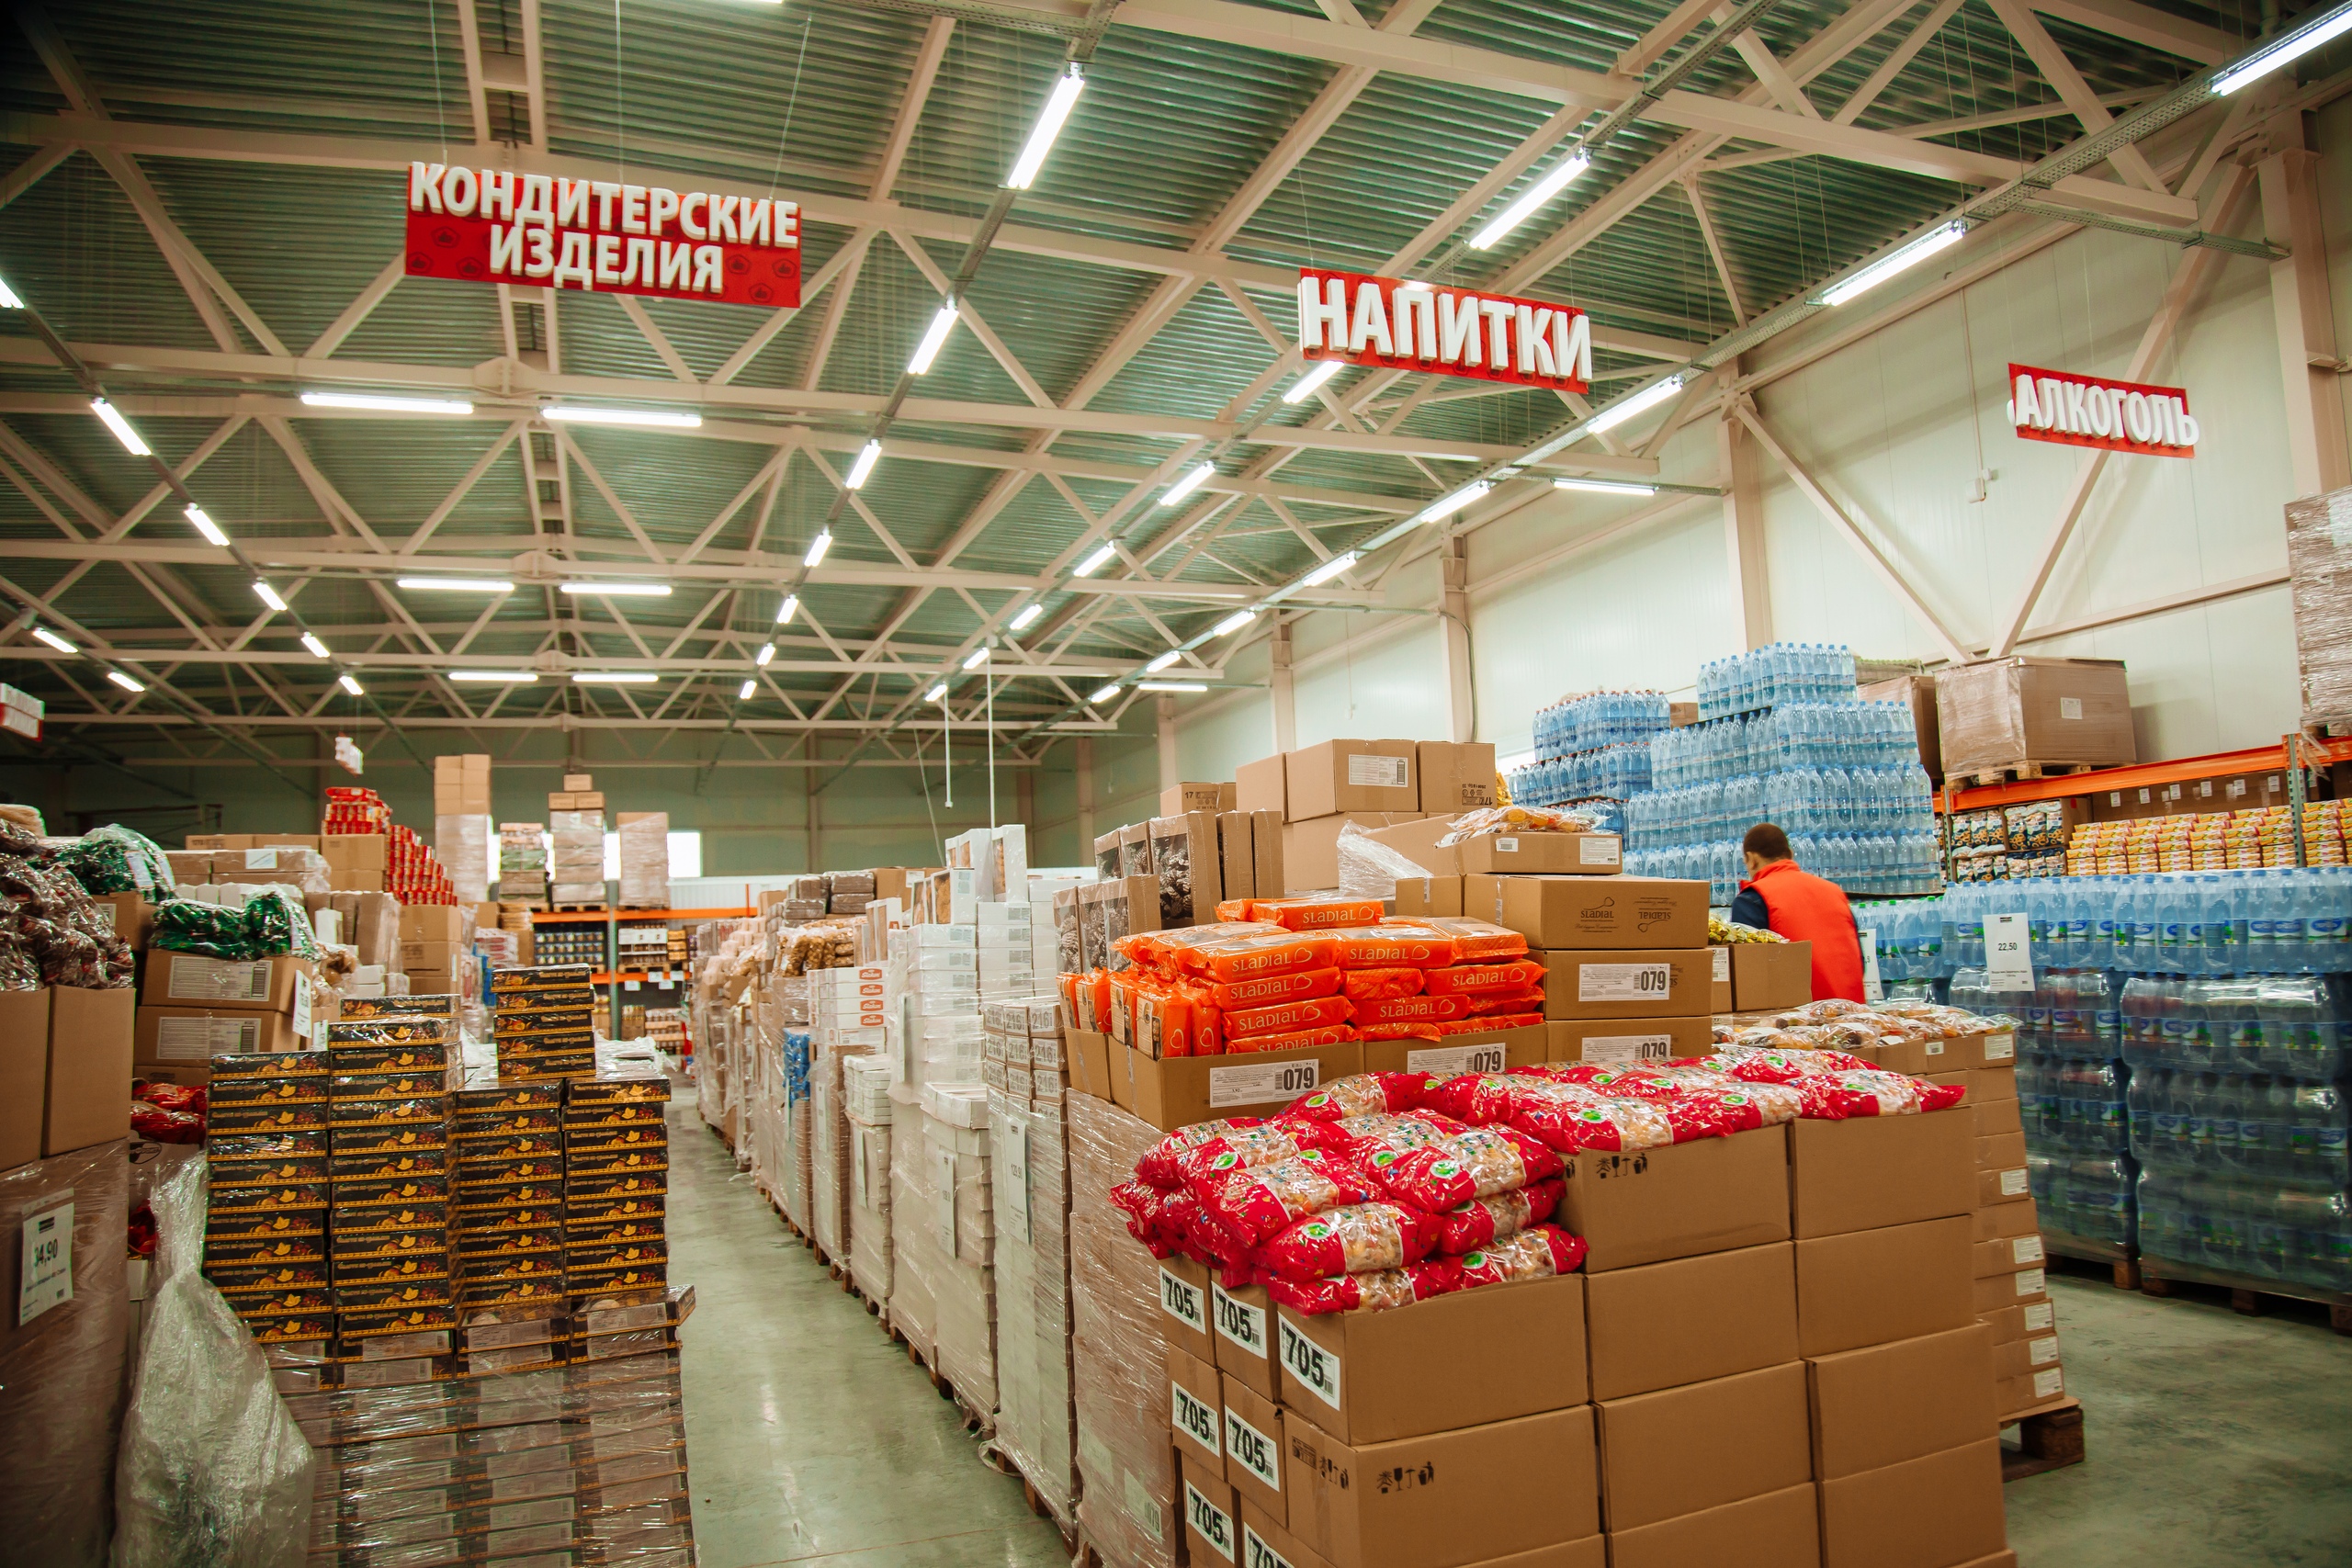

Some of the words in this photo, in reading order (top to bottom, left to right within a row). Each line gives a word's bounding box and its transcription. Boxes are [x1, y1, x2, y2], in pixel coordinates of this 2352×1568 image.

[411, 162, 798, 249] КОНДИТЕРСКИЕ
[489, 224, 723, 293] ИЗДЕЛИЯ
[1299, 276, 1592, 382] НАПИТКИ
[2016, 374, 2199, 447] АЛКОГОЛЬ
[1185, 791, 1193, 799] 17
[1998, 942, 2018, 952] 22,50
[1641, 971, 1667, 991] 079
[1032, 1011, 1049, 1030] 216
[1035, 1044, 1053, 1064] 216
[1474, 1051, 1500, 1072] 079
[1642, 1042, 1667, 1058] 079
[1036, 1072, 1054, 1093] 216
[1283, 1067, 1314, 1090] 079
[1165, 1276, 1194, 1320] 705
[1218, 1293, 1252, 1343] 705
[1285, 1326, 1324, 1388] 705
[1180, 1392, 1211, 1440] 705
[1232, 1416, 1266, 1473] 705
[1193, 1493, 1224, 1545] 705
[1253, 1536, 1288, 1568] 70
